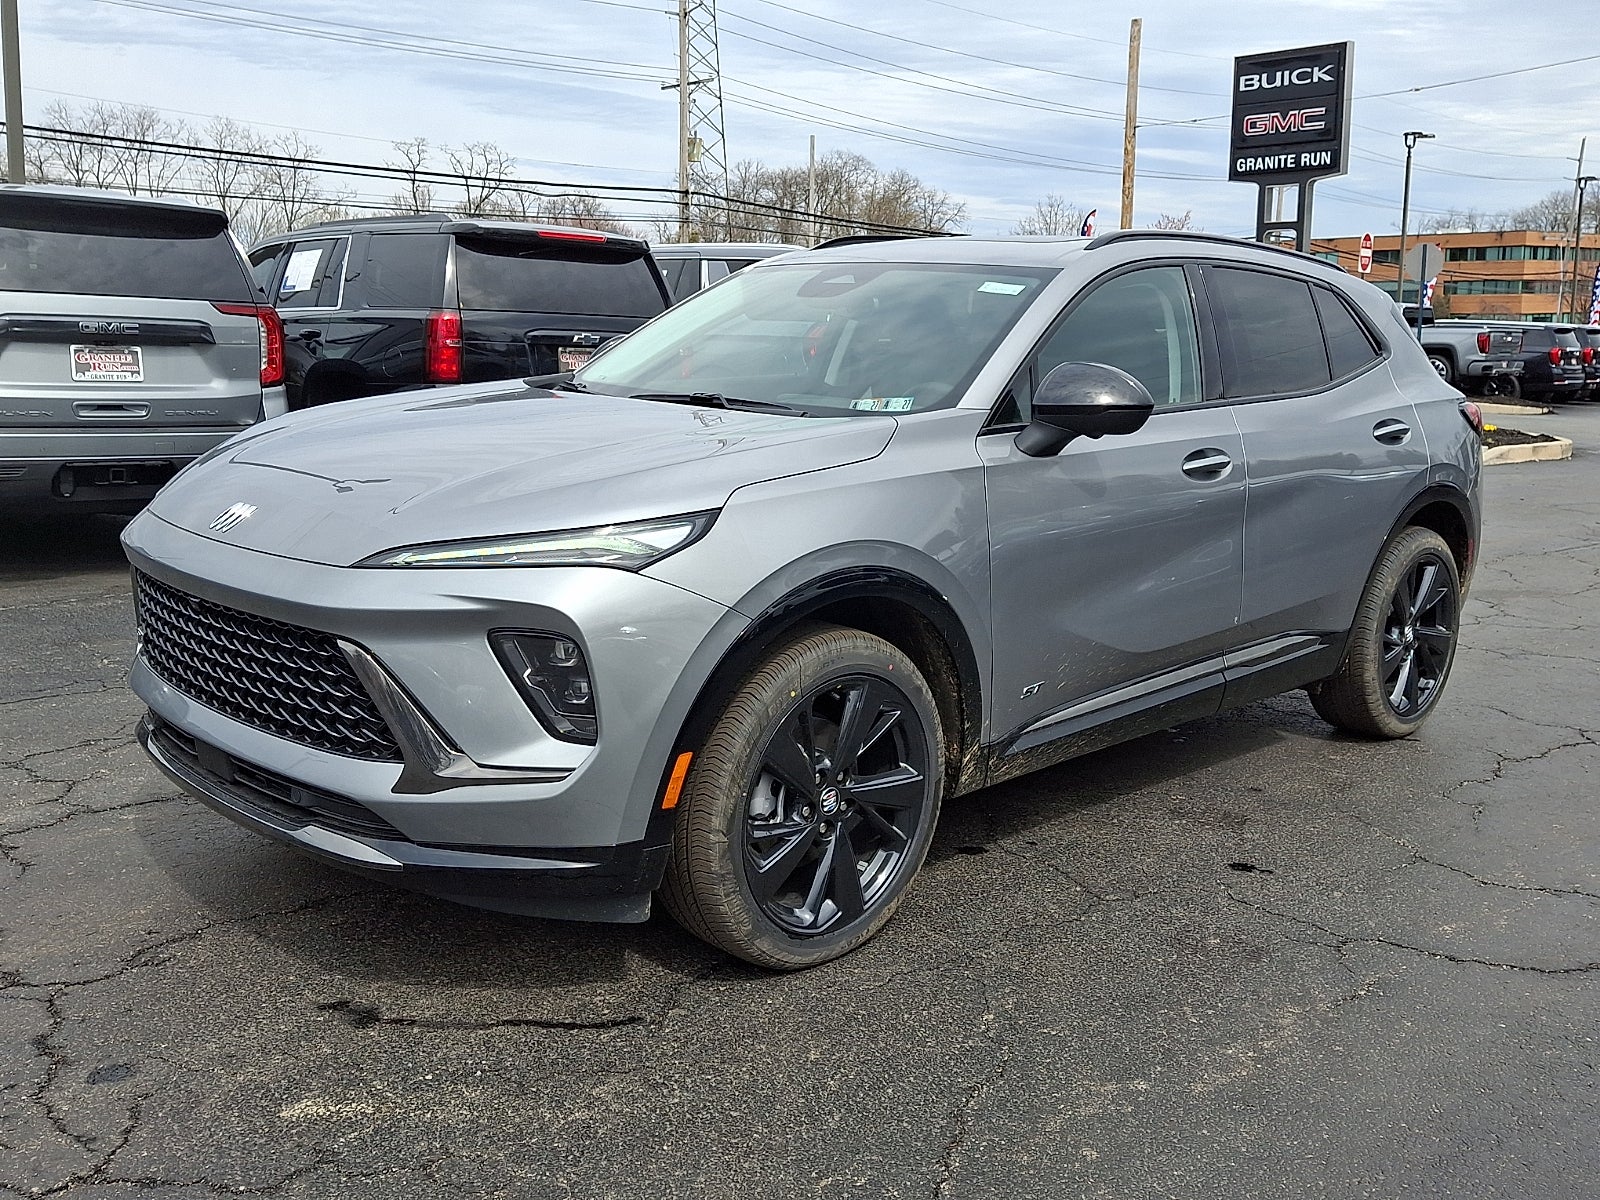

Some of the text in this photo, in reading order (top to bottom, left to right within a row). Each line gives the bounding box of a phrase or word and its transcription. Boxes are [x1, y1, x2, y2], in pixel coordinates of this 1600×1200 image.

[1239, 64, 1335, 92] BUICK
[1243, 107, 1326, 136] GMC
[1236, 151, 1332, 172] GRANITE RUN
[79, 321, 139, 334] GMC
[75, 352, 133, 363] GRANITE
